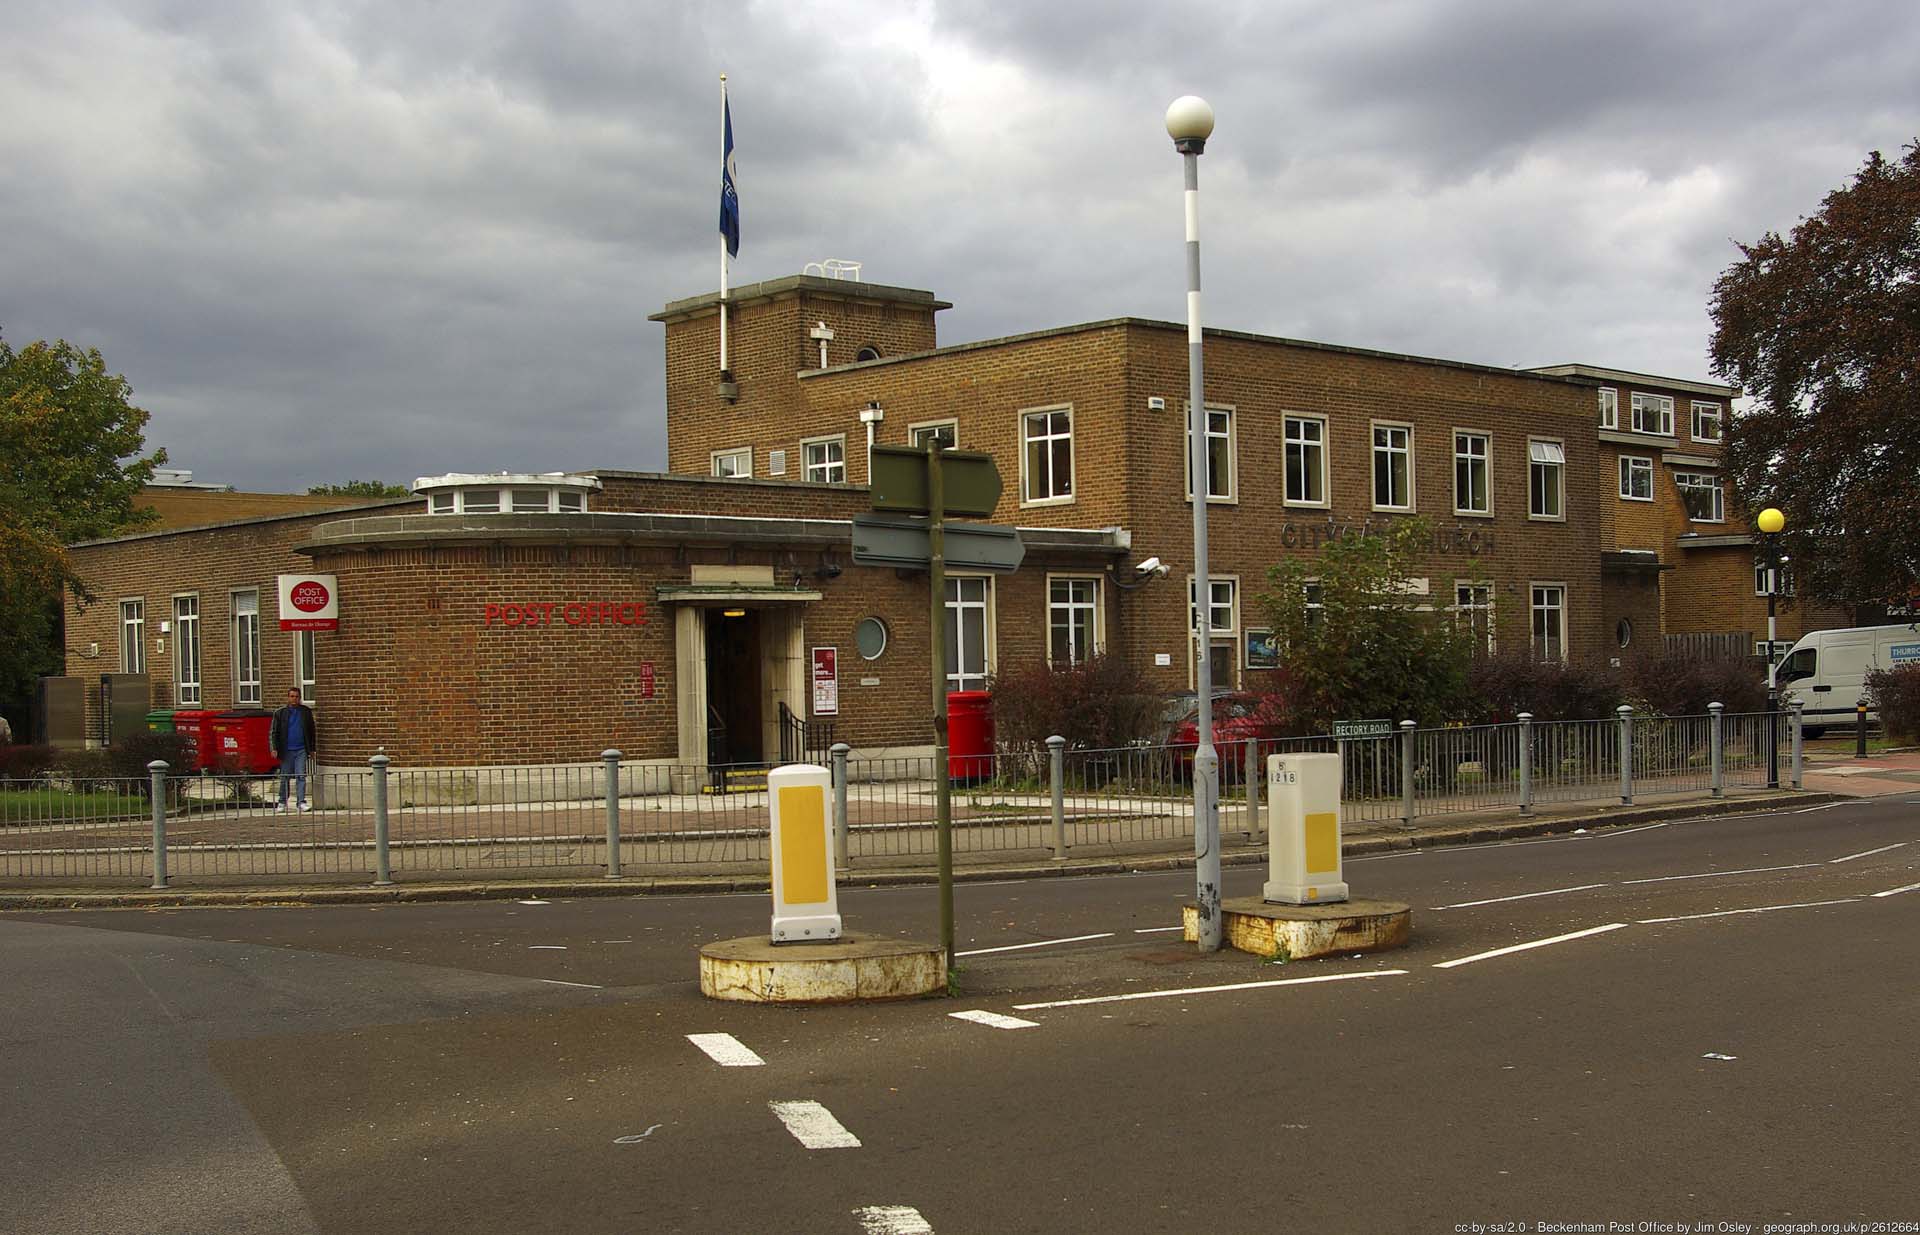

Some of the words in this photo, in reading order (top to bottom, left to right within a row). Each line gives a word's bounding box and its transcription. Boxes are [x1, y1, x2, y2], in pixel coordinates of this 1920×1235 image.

[299, 588, 321, 596] POST
[294, 596, 326, 605] OFFICE
[485, 602, 556, 627] POST
[563, 602, 648, 625] OFFICE
[1336, 726, 1367, 735] RECTORY
[1370, 724, 1390, 733] ROAD
